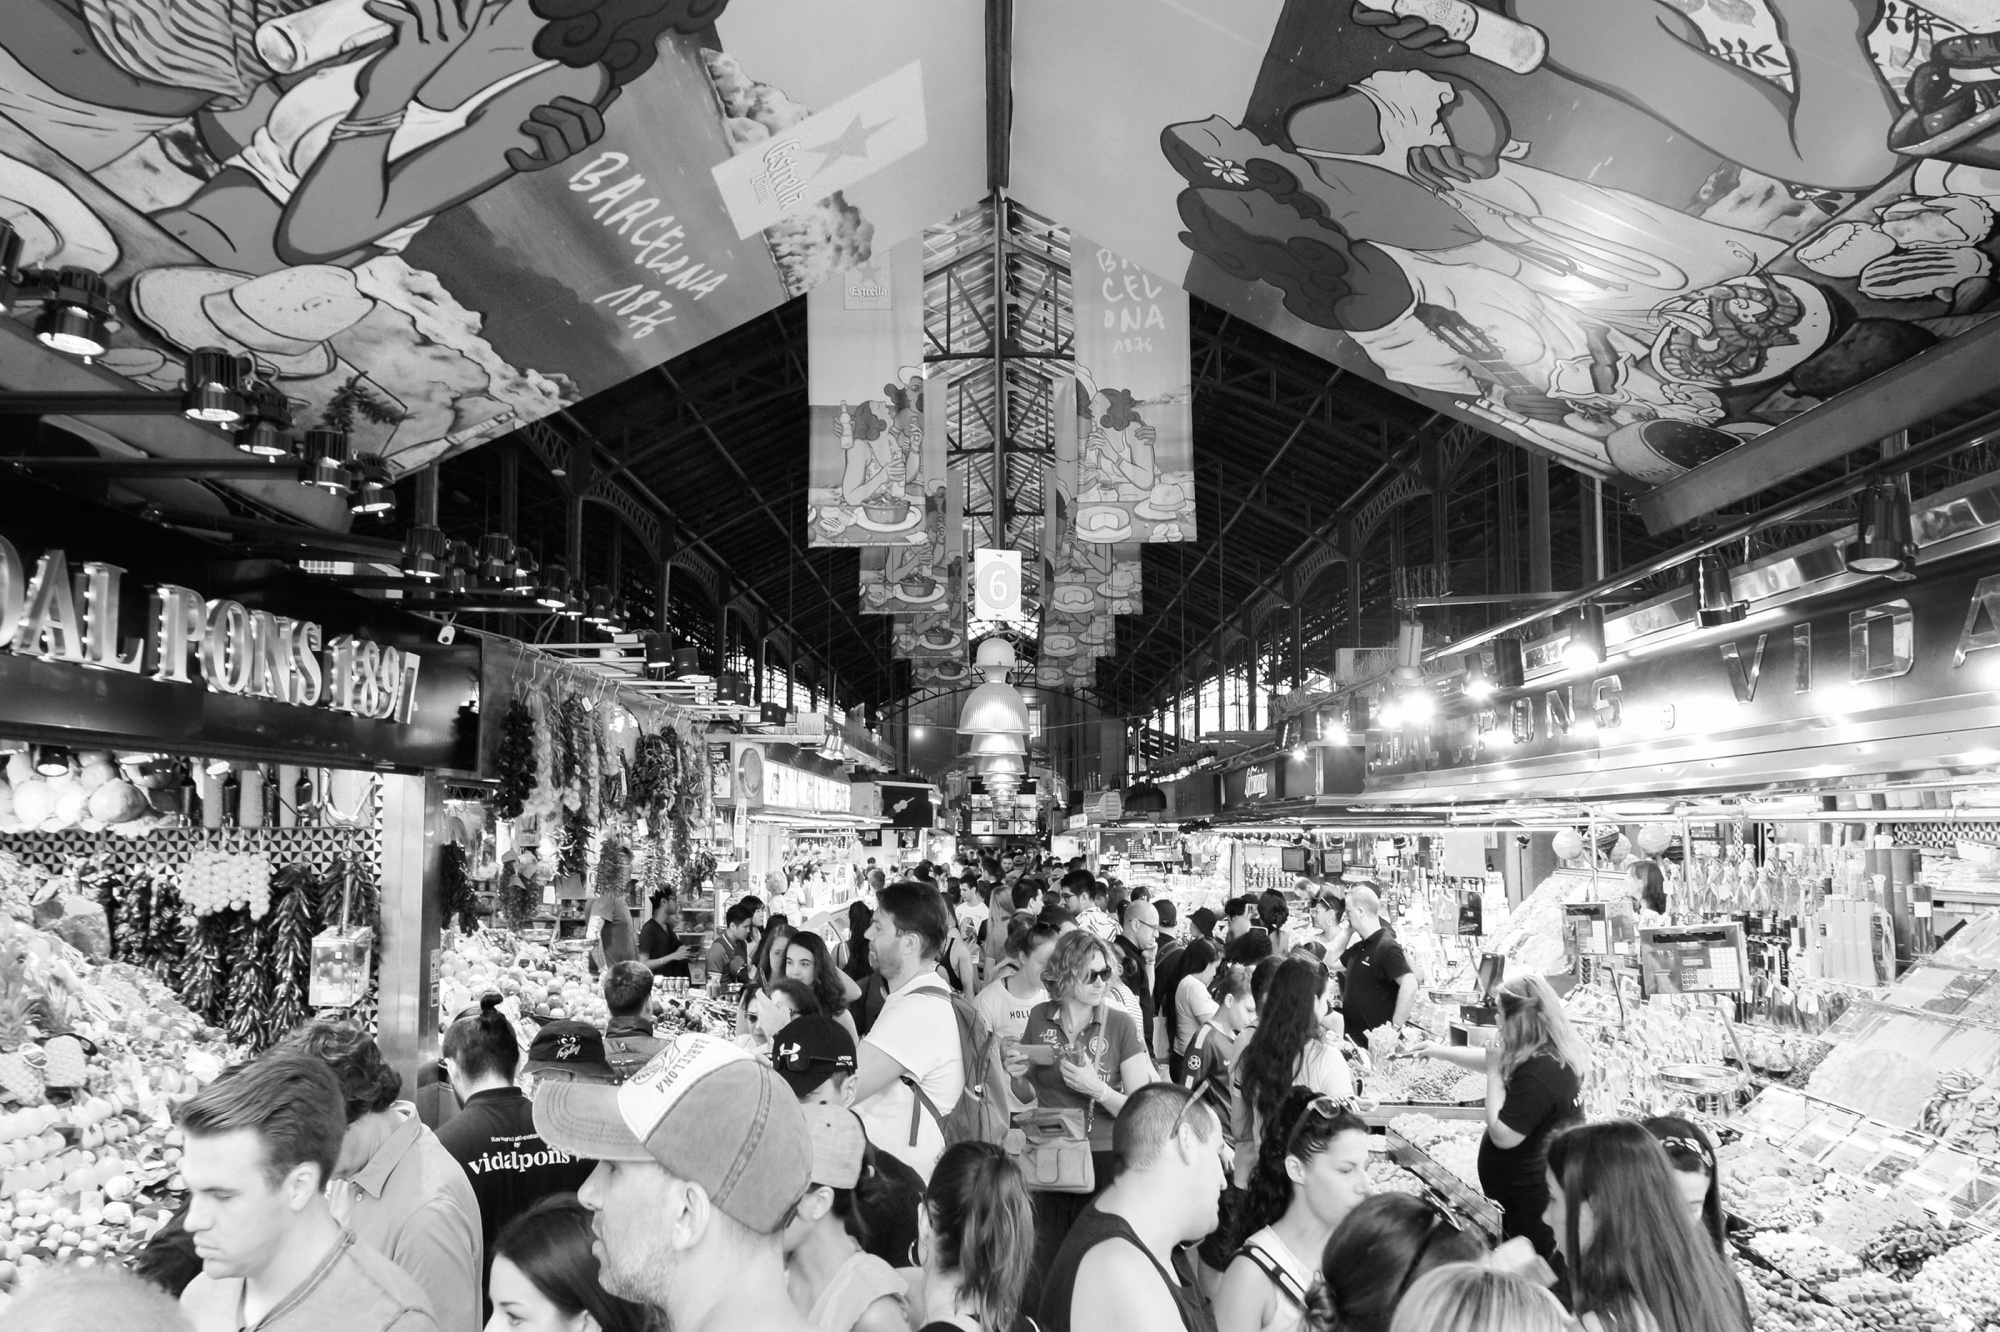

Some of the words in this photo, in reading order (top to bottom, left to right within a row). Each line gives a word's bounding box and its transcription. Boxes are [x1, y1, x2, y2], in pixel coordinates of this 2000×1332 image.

[763, 138, 810, 211] Estrella
[569, 151, 728, 300] BARCELONA
[848, 285, 888, 298] Estrella
[1102, 274, 1162, 302] CEL
[594, 284, 677, 340] 1876
[1113, 336, 1153, 354] 1876
[989, 568, 1008, 602] 6
[149, 582, 322, 708] PONS
[324, 633, 421, 724] 1897
[467, 1149, 571, 1175] vidalpons
